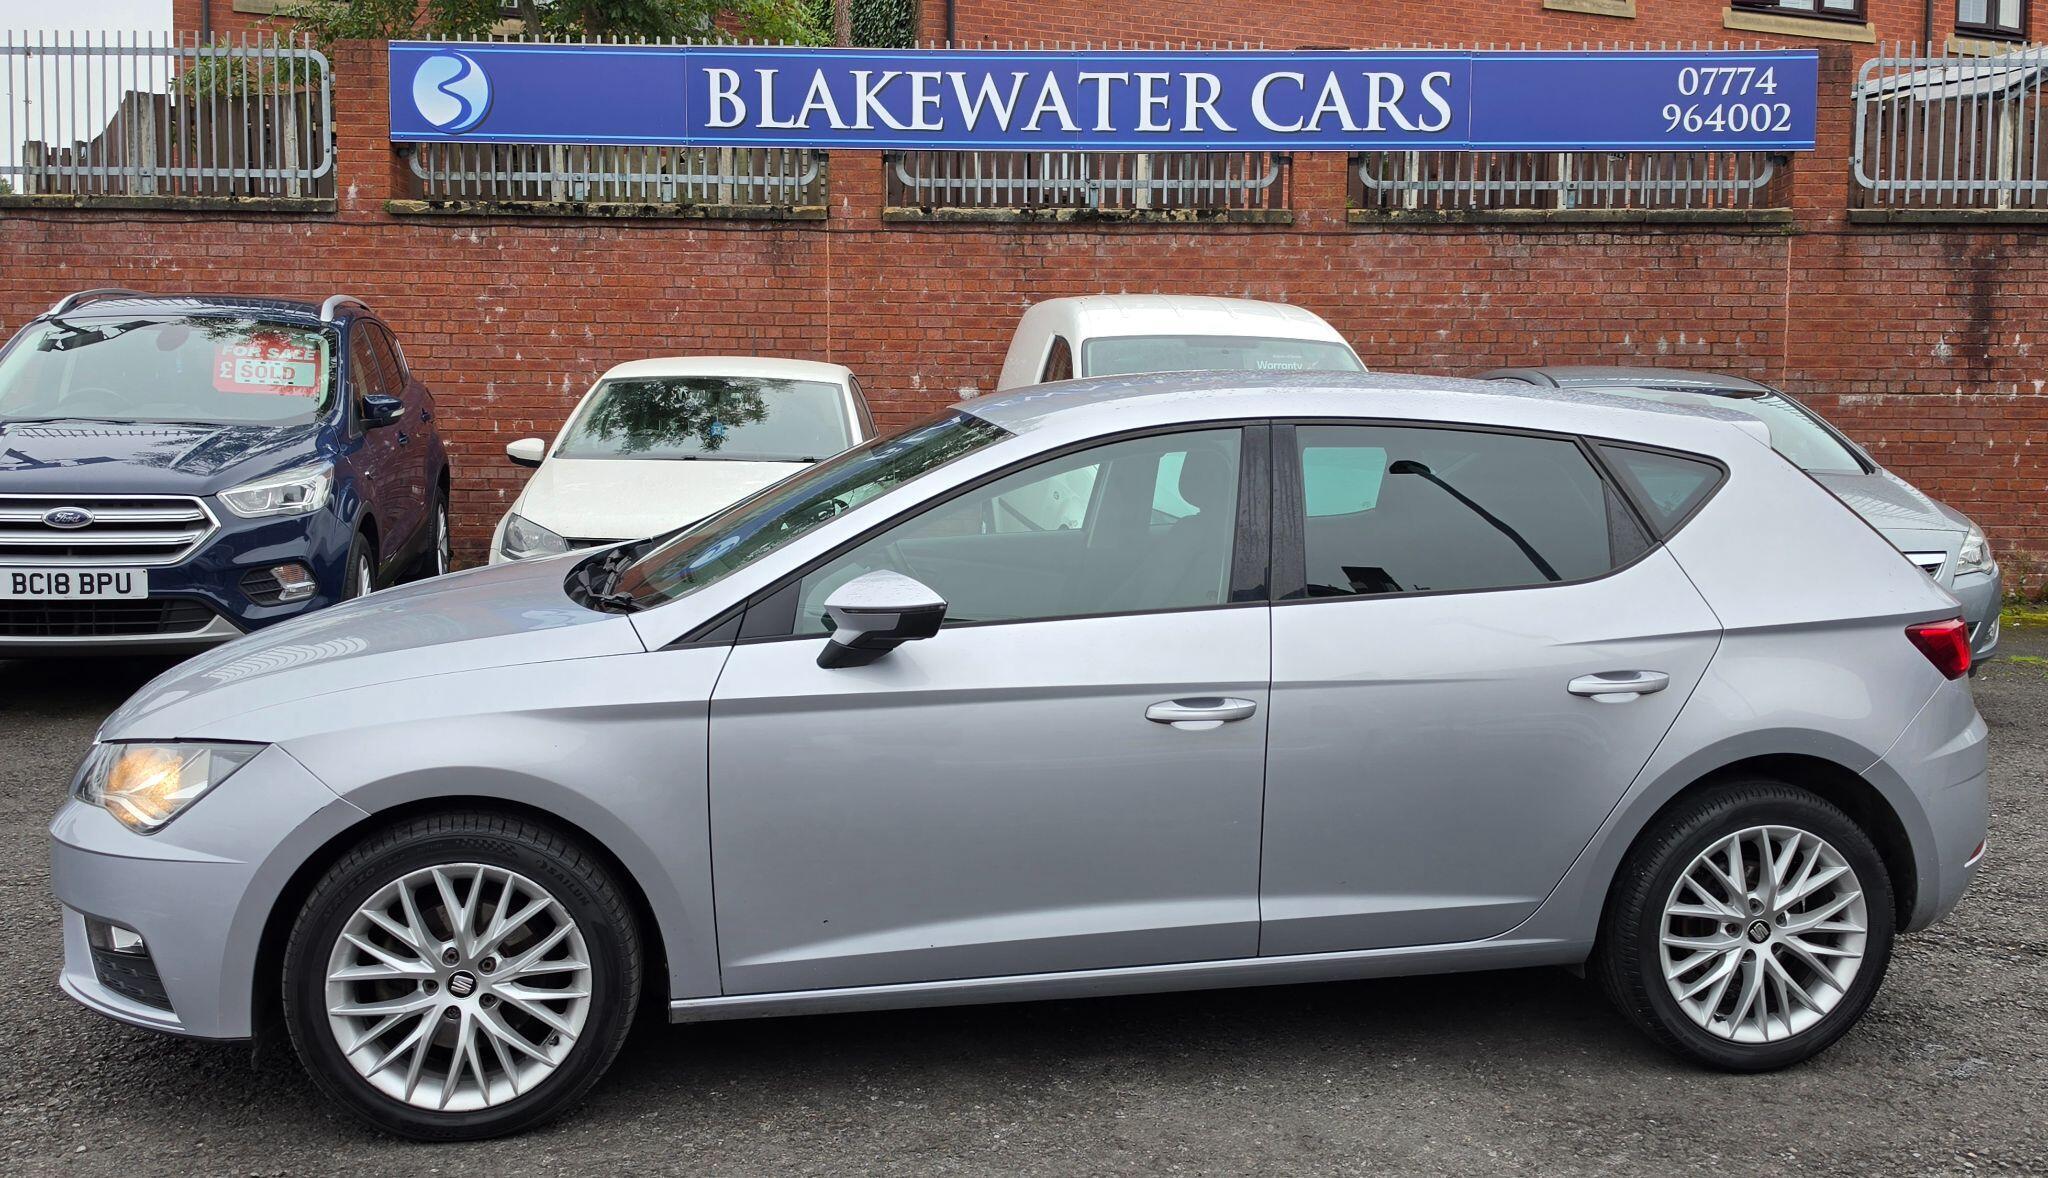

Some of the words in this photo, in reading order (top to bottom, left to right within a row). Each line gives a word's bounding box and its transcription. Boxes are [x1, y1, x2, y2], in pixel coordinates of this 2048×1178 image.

[1679, 67, 1777, 95] 07774
[703, 68, 1237, 131] BLAKEWATER
[1252, 71, 1450, 131] CARS
[1663, 104, 1791, 132] 964002
[222, 345, 261, 356] FOR
[241, 364, 296, 380] SOLD
[12, 573, 70, 594] BC18
[79, 573, 131, 594] BPU
